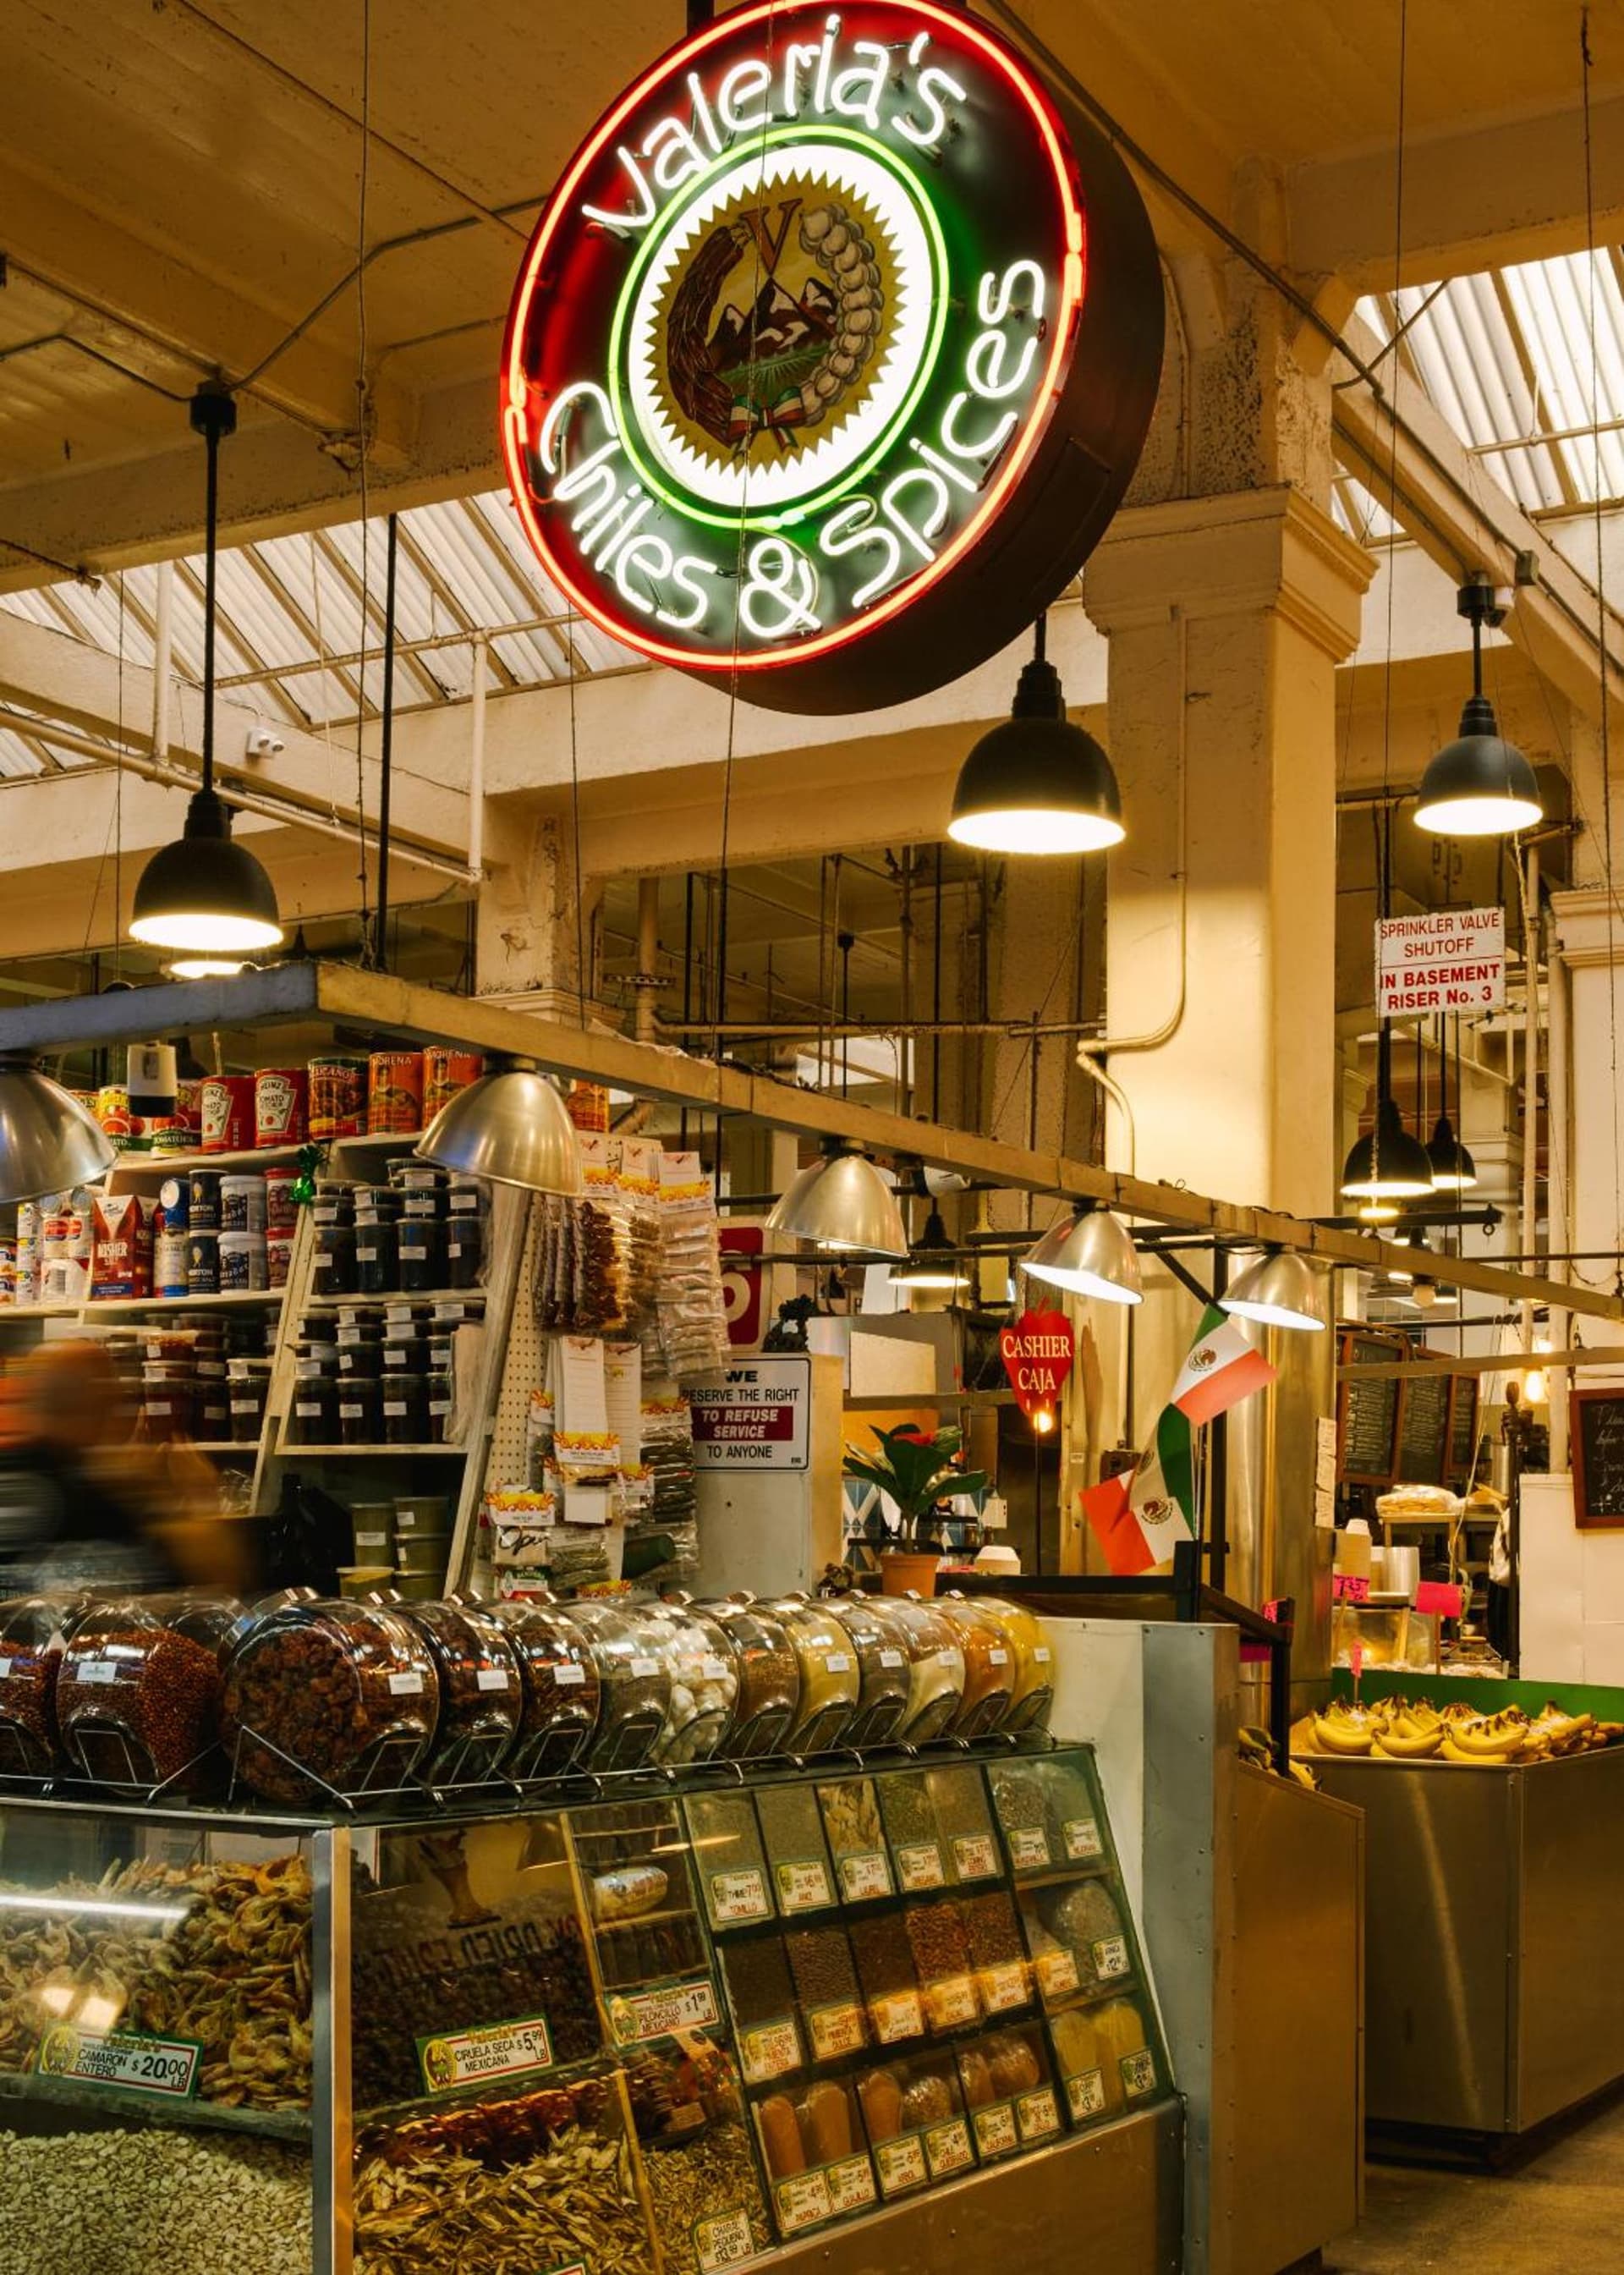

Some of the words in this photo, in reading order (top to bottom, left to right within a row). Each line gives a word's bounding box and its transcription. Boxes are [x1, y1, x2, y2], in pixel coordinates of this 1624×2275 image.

[581, 14, 968, 230] Valeria's
[540, 382, 718, 629] Chiles
[738, 536, 822, 639] &
[820, 258, 1045, 609] Spices
[1380, 918, 1454, 939] SPRINKLER
[1460, 913, 1500, 930] VALVE
[1404, 937, 1474, 958] SHUTOFF
[1380, 974, 1396, 990] IN
[1403, 964, 1501, 987] BASEMENT
[1387, 991, 1440, 1009] RISER
[1446, 988, 1474, 1004] No.
[1482, 986, 1492, 1001] 3
[1002, 1335, 1072, 1358] CASHIER
[726, 1370, 758, 1382] WE
[1018, 1367, 1056, 1394] CAJA
[738, 1388, 760, 1401] THE
[765, 1388, 800, 1401] RIGHT
[702, 1409, 719, 1421] TO
[725, 1409, 779, 1422] REFUSE
[713, 1425, 766, 1438] SERVICE
[707, 1445, 721, 1458] TO
[726, 1445, 772, 1458] ANYONE
[492, 2039, 515, 2054] SECA
[77, 2048, 129, 2067] CAMARON
[464, 2053, 510, 2073] MEXICANA
[74, 2060, 118, 2077] ENTERO
[171, 2076, 186, 2089] LB
